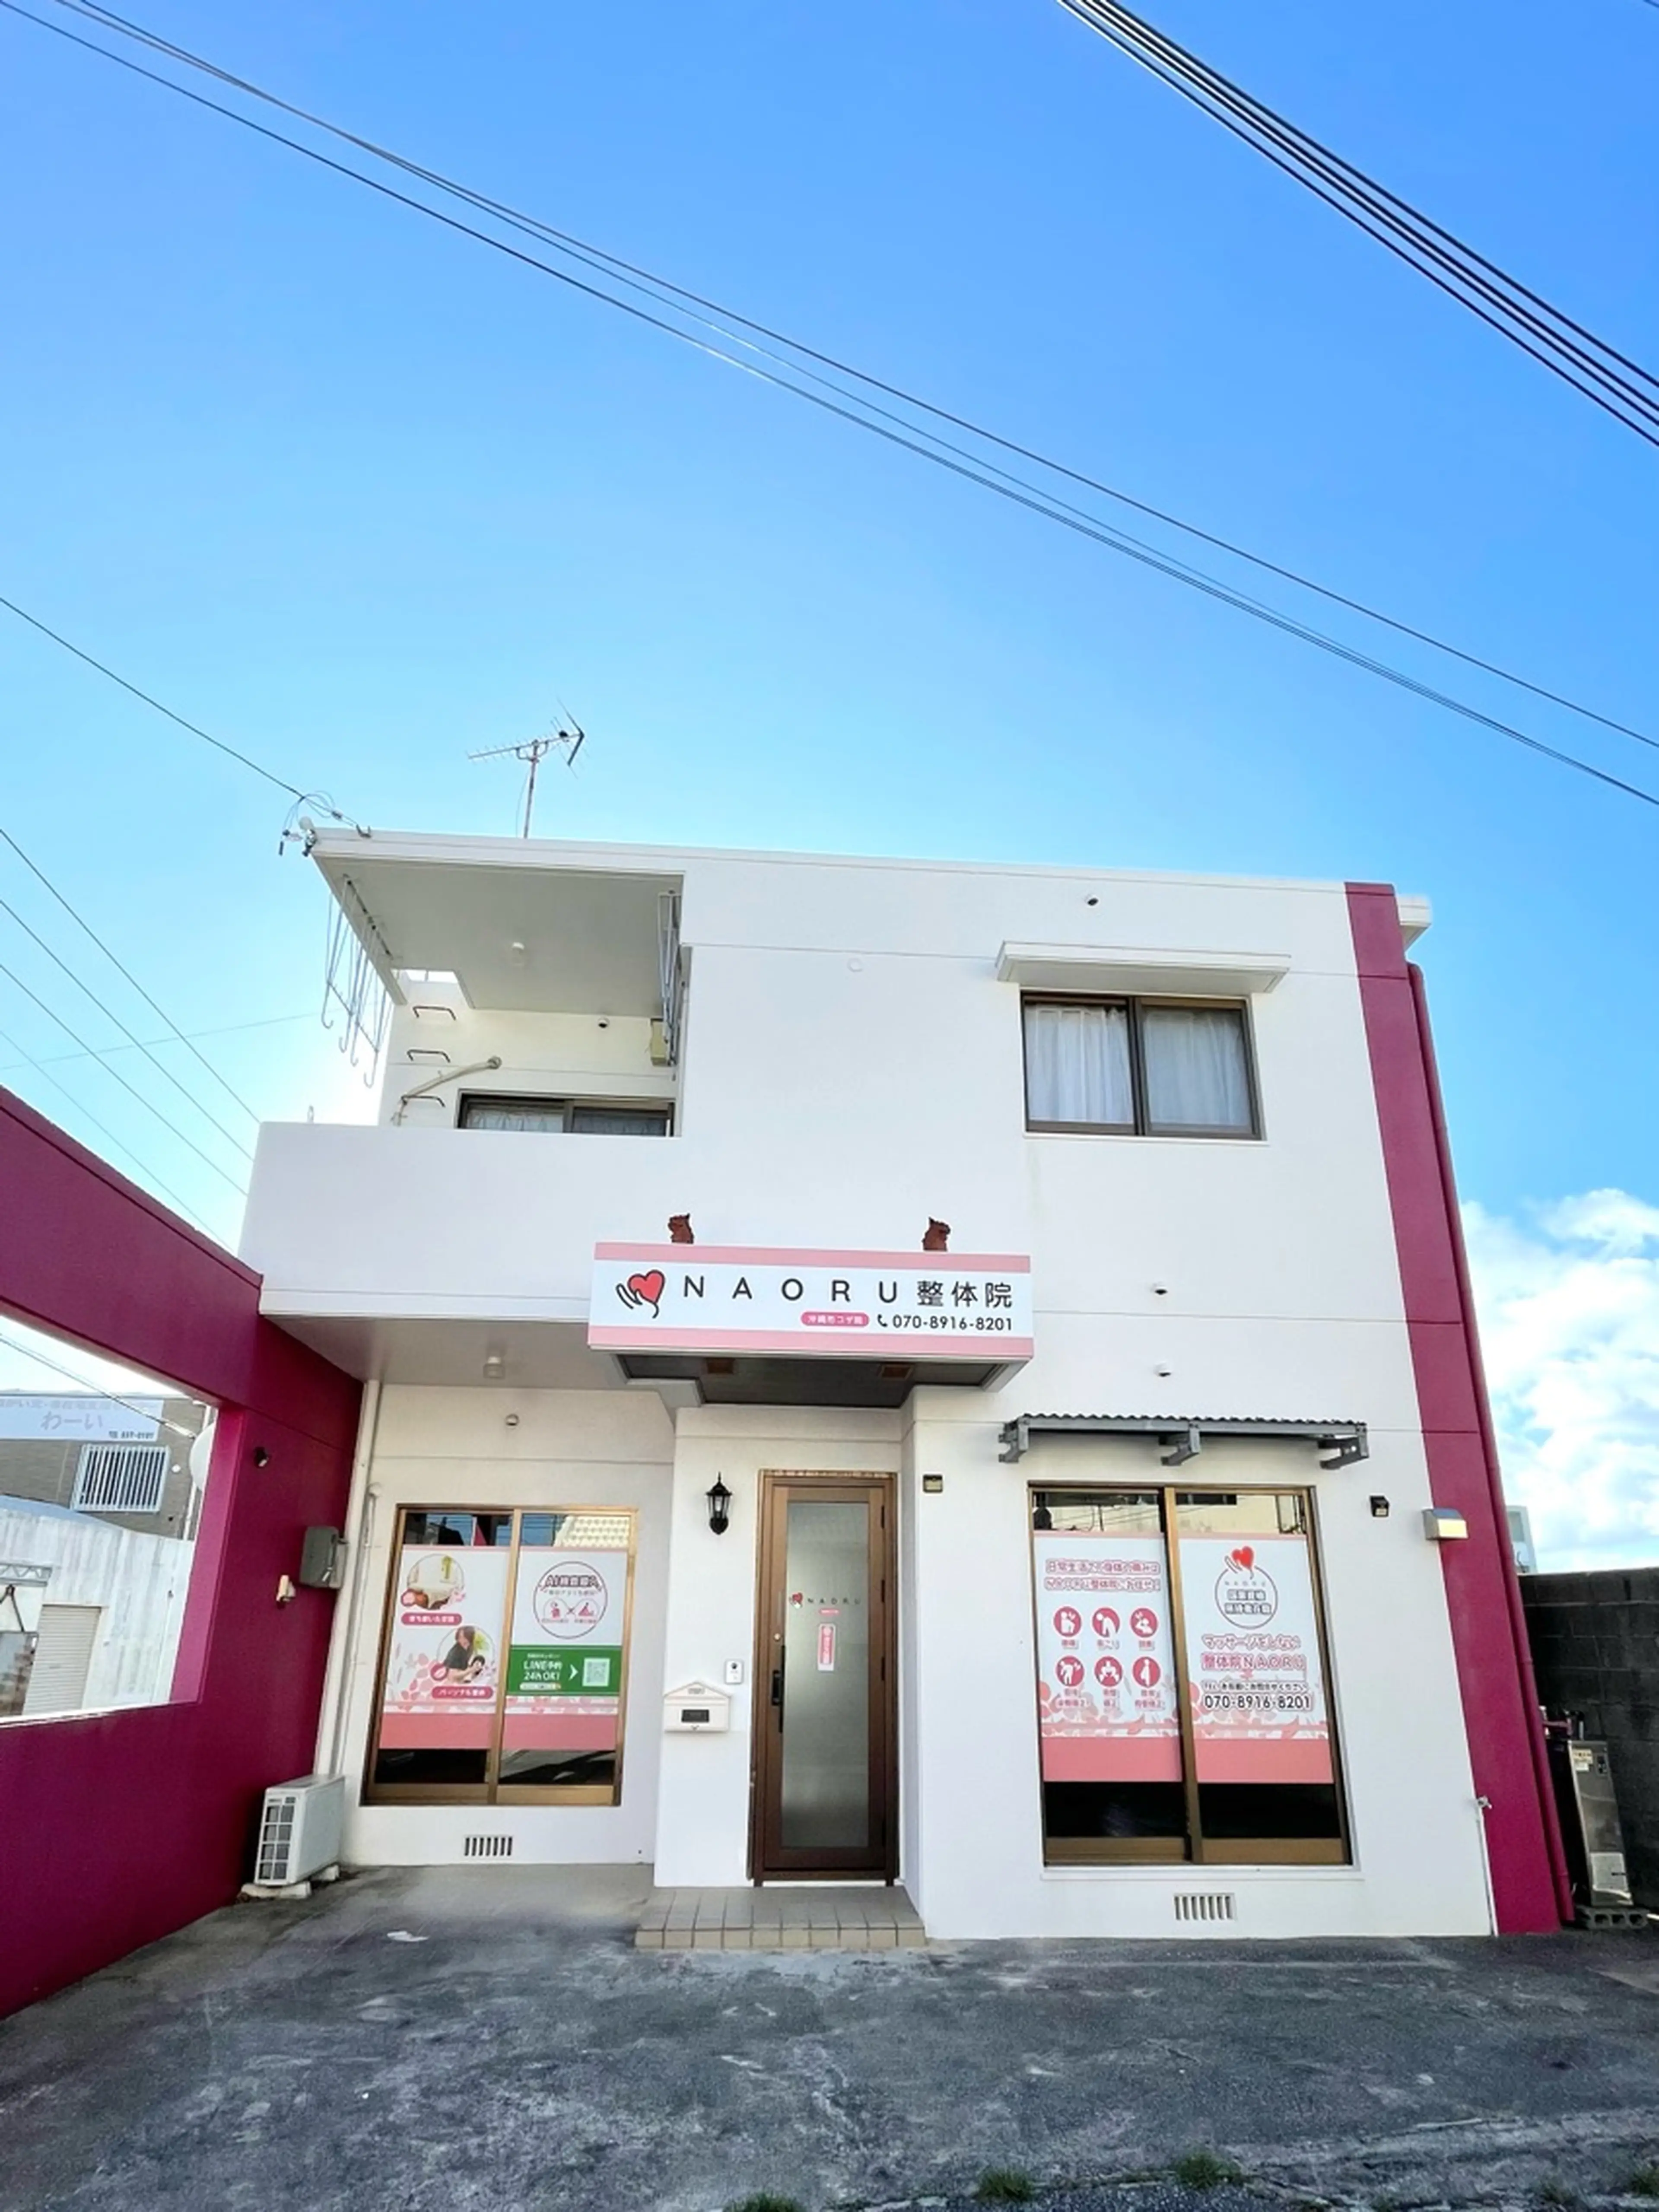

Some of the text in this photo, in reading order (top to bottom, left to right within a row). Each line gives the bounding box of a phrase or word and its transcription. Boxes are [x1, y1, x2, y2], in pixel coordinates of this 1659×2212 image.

[683, 1275, 1012, 1308] NAORU 整体院
[892, 1314, 1012, 1331] 070-8916-8201
